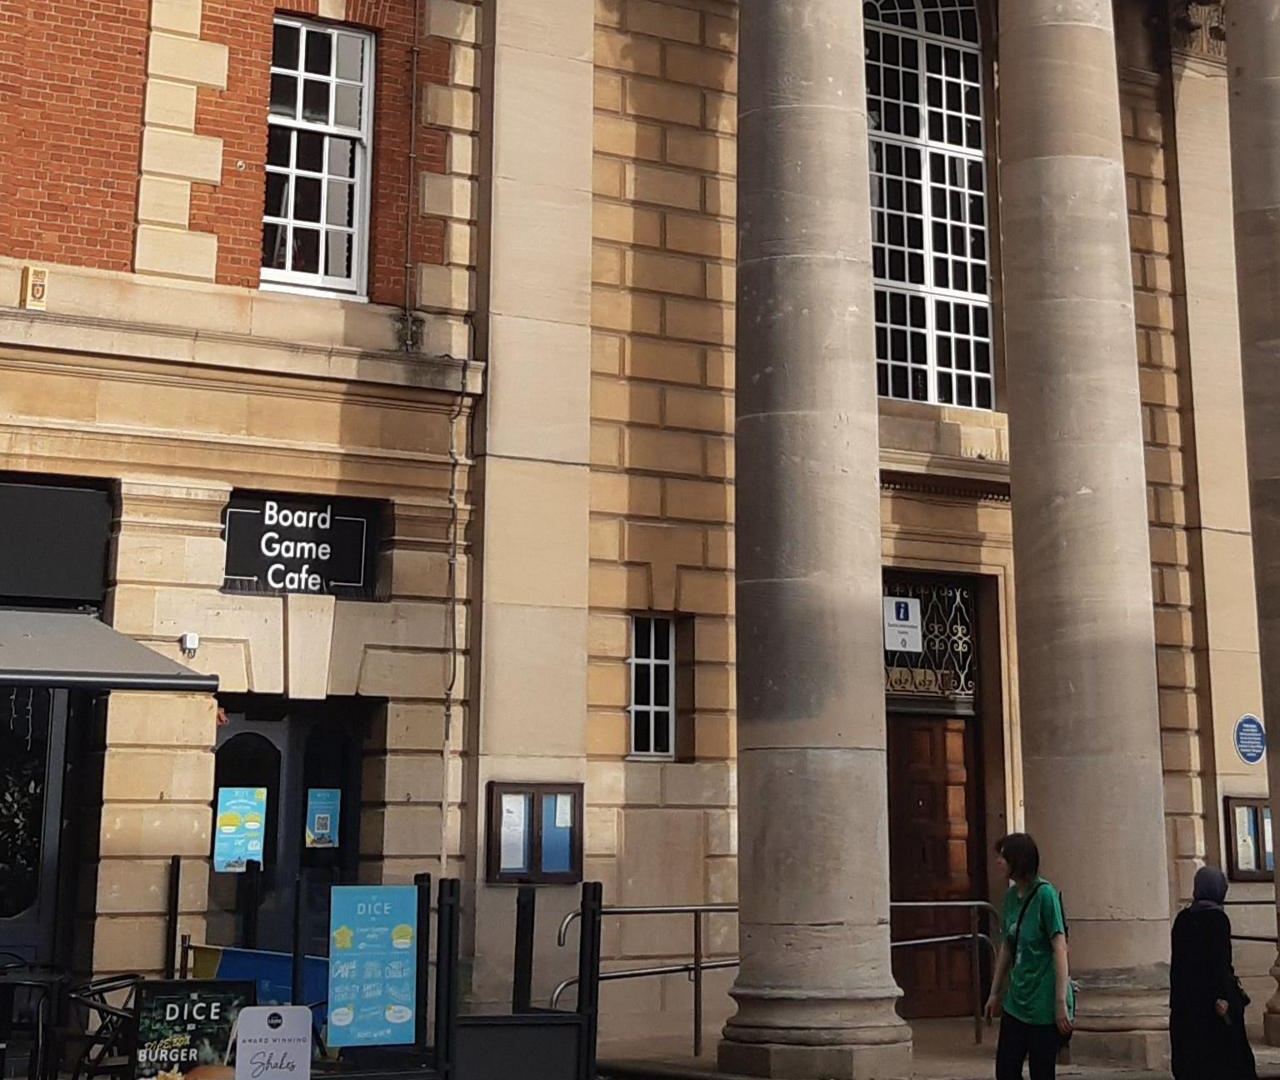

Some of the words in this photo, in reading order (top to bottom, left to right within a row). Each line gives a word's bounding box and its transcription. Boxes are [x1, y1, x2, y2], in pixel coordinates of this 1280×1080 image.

[263, 501, 332, 529] Board
[260, 531, 331, 560] Game
[267, 563, 322, 591] Cafe
[357, 902, 393, 915] DICE
[165, 1002, 221, 1021] DICE
[242, 1037, 269, 1045] AWARD
[272, 1036, 308, 1044] WINNING
[138, 1047, 198, 1062] BURGER
[250, 1051, 296, 1078] Shakes
